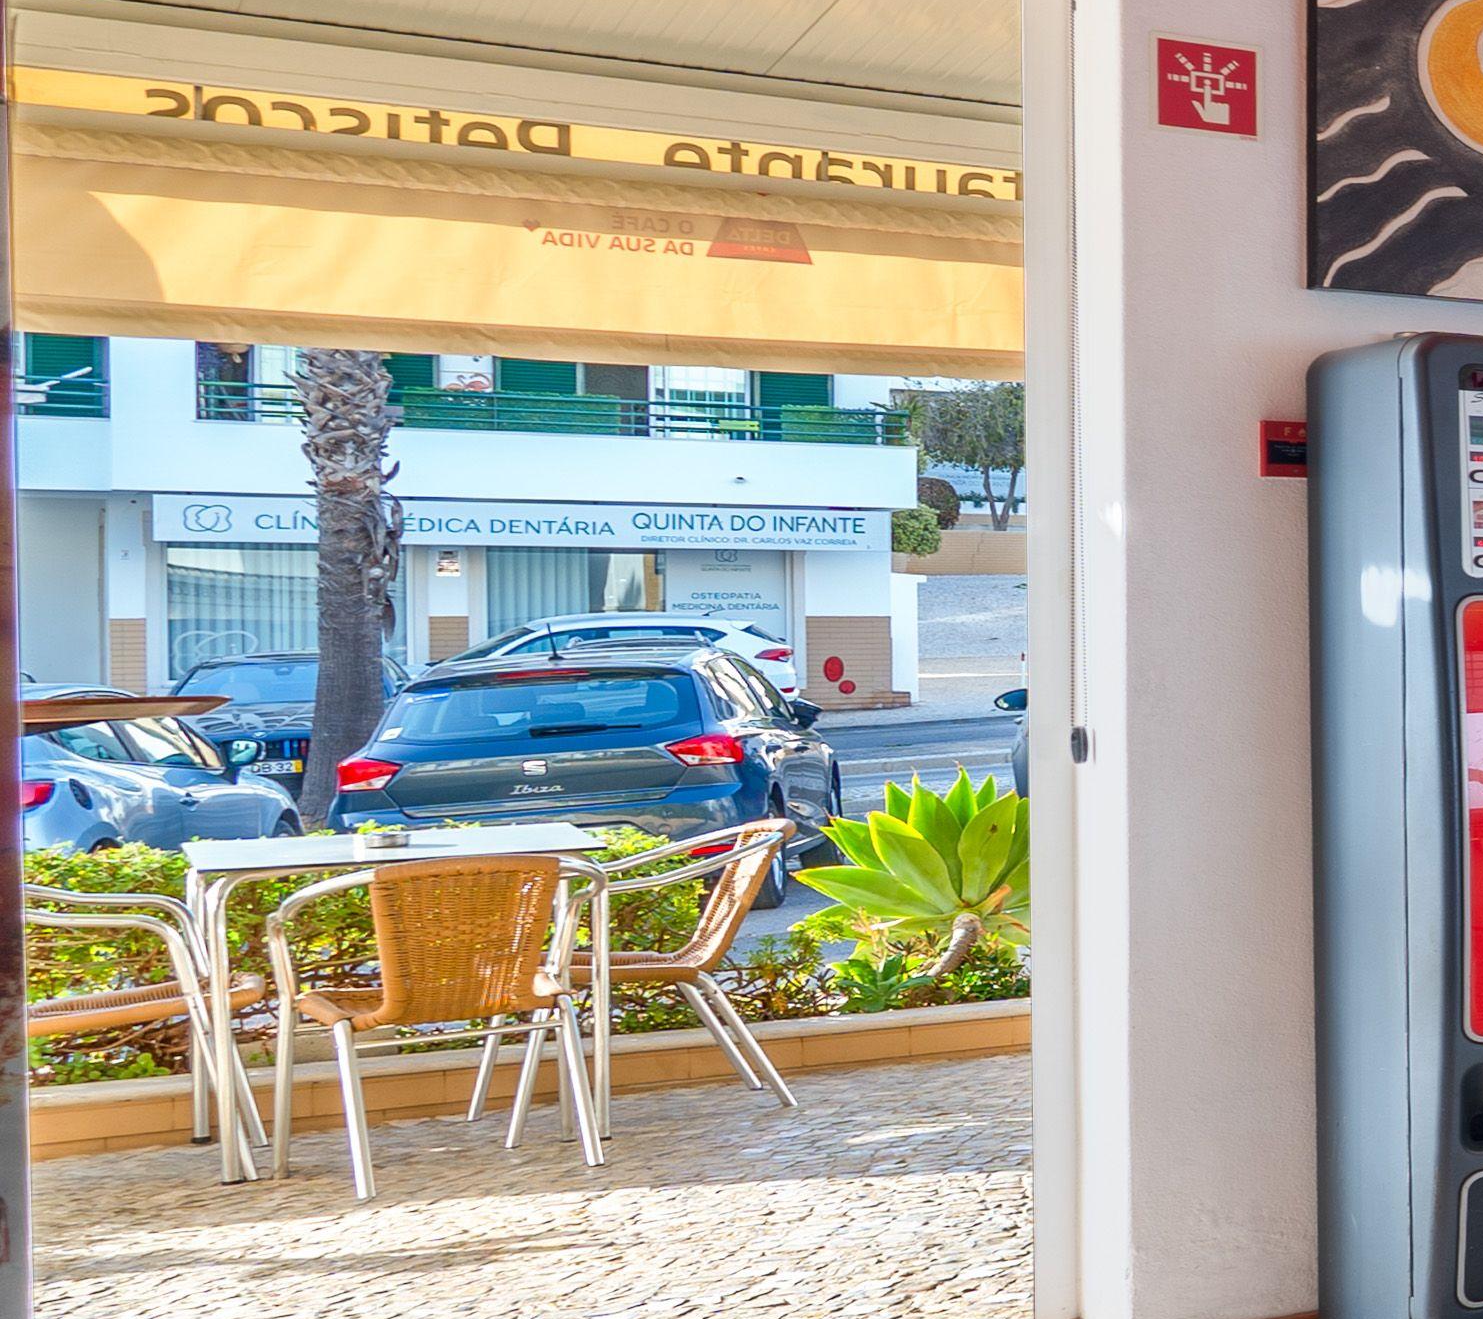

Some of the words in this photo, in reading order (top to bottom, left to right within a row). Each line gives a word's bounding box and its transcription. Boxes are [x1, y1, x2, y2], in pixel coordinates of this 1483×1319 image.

[254, 510, 318, 531] CLÍN
[401, 516, 480, 533] ÉDICA
[490, 516, 616, 536] DENTÁRIA
[632, 512, 724, 531] QUINTA
[730, 514, 767, 533] DO
[773, 516, 867, 534] INFANTE
[641, 535, 686, 543] DIRETOR
[751, 537, 793, 545] CARLOS
[814, 538, 857, 546] CORREIA
[690, 592, 762, 600] OSTEOPATIA
[672, 602, 725, 611] MEDICINA
[510, 784, 565, 795] Ibiza
